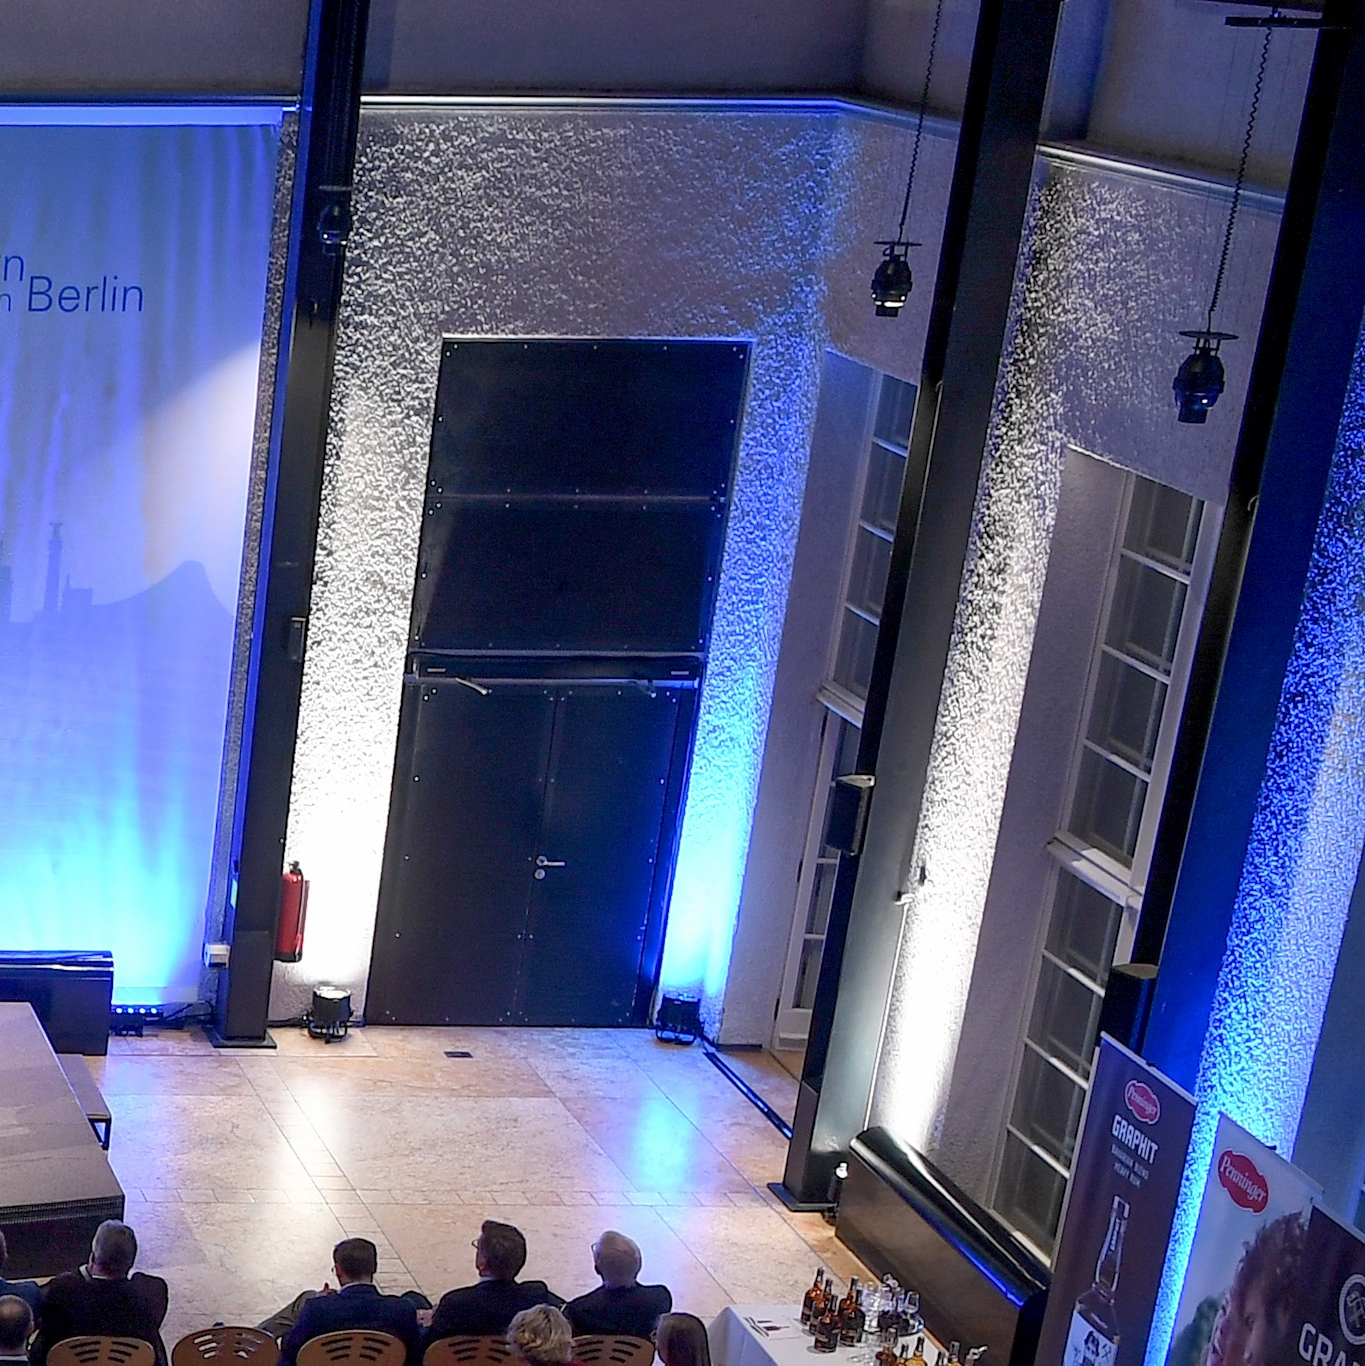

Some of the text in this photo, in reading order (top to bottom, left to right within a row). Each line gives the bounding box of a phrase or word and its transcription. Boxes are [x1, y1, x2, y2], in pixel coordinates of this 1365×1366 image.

[27, 275, 144, 313] Berlin
[1112, 1114, 1159, 1165] GRAPHIT
[1219, 1155, 1267, 1202] Penninger
